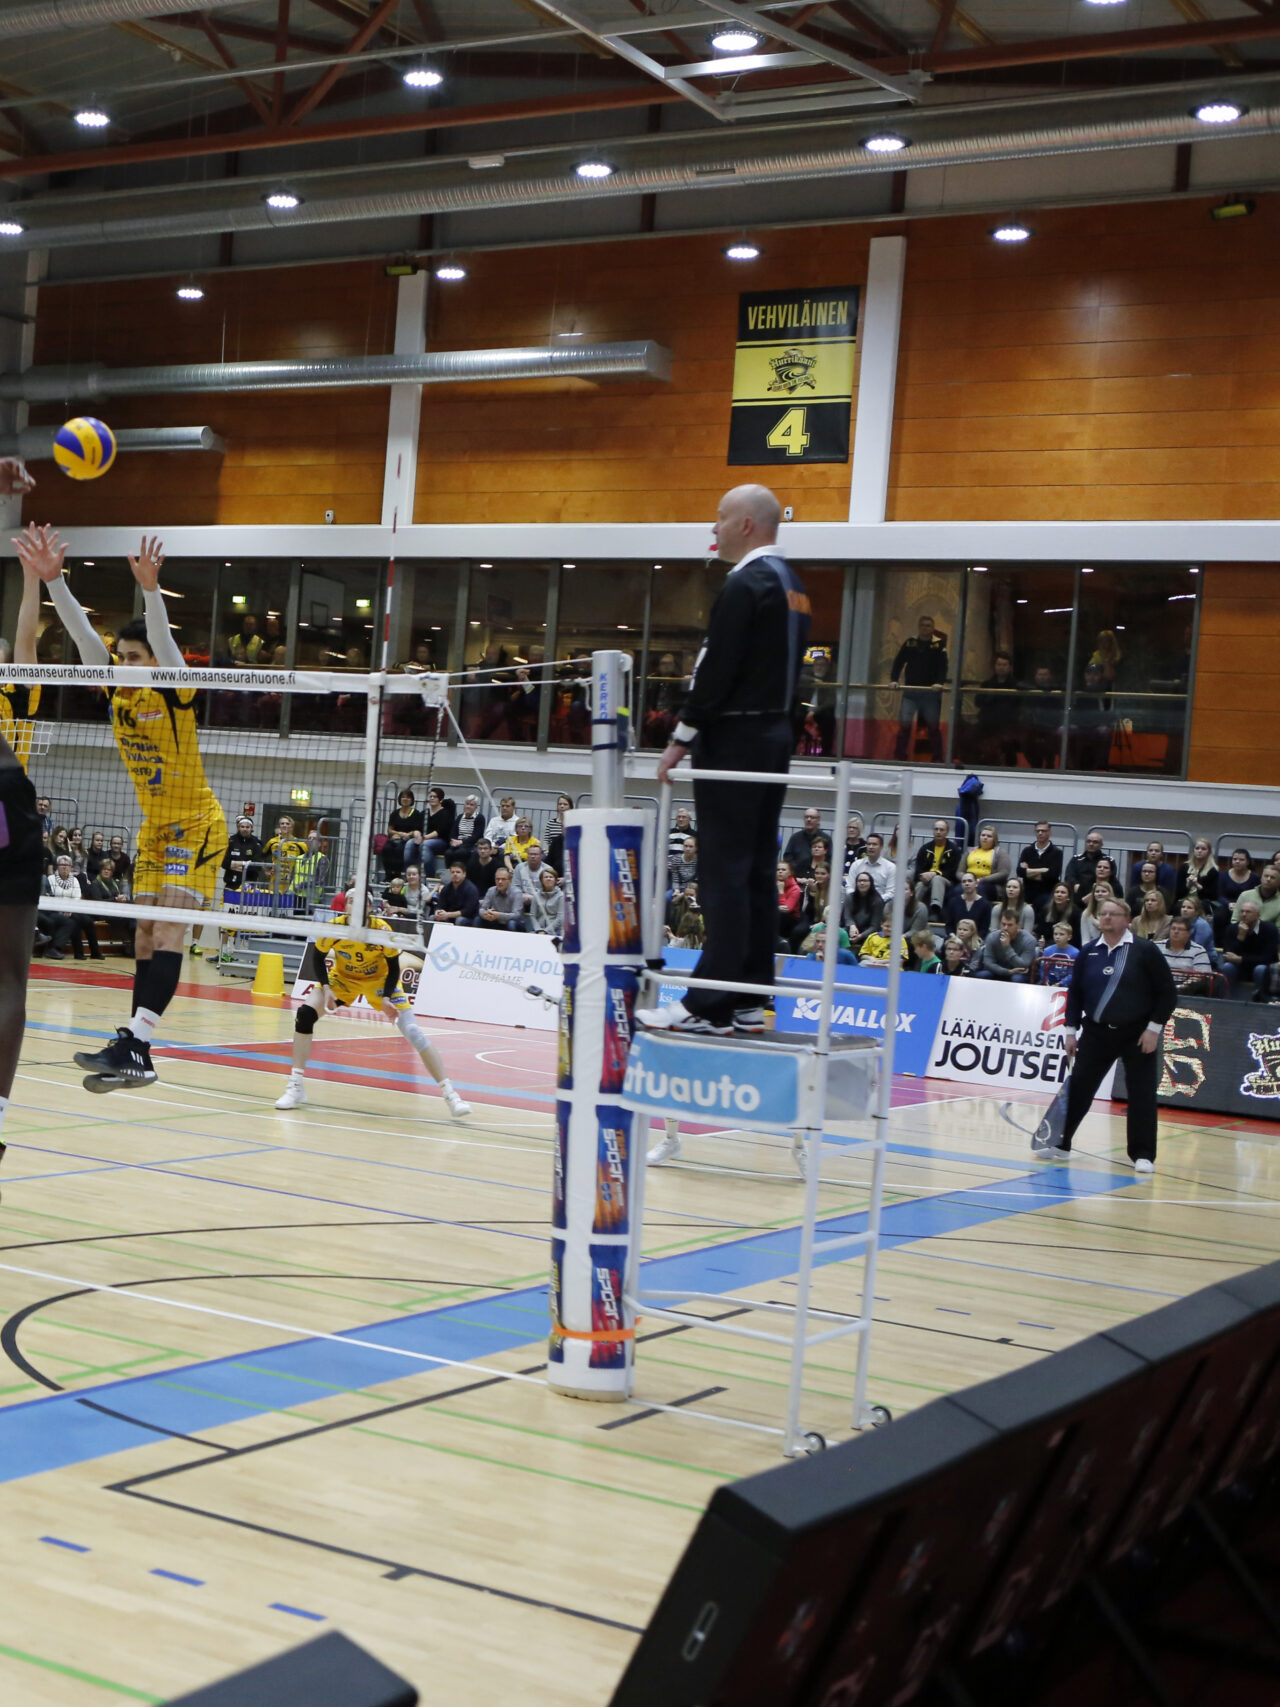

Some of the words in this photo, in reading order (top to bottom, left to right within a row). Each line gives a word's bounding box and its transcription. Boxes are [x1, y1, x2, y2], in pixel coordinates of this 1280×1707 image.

[747, 299, 849, 331] VEHVILÄINEN
[766, 406, 811, 457] 4
[150, 670, 297, 686] www.loimaanseurahuone.fi
[117, 706, 137, 729] 16
[355, 952, 364, 962] 9
[463, 950, 564, 976] LÄHITAPIOL
